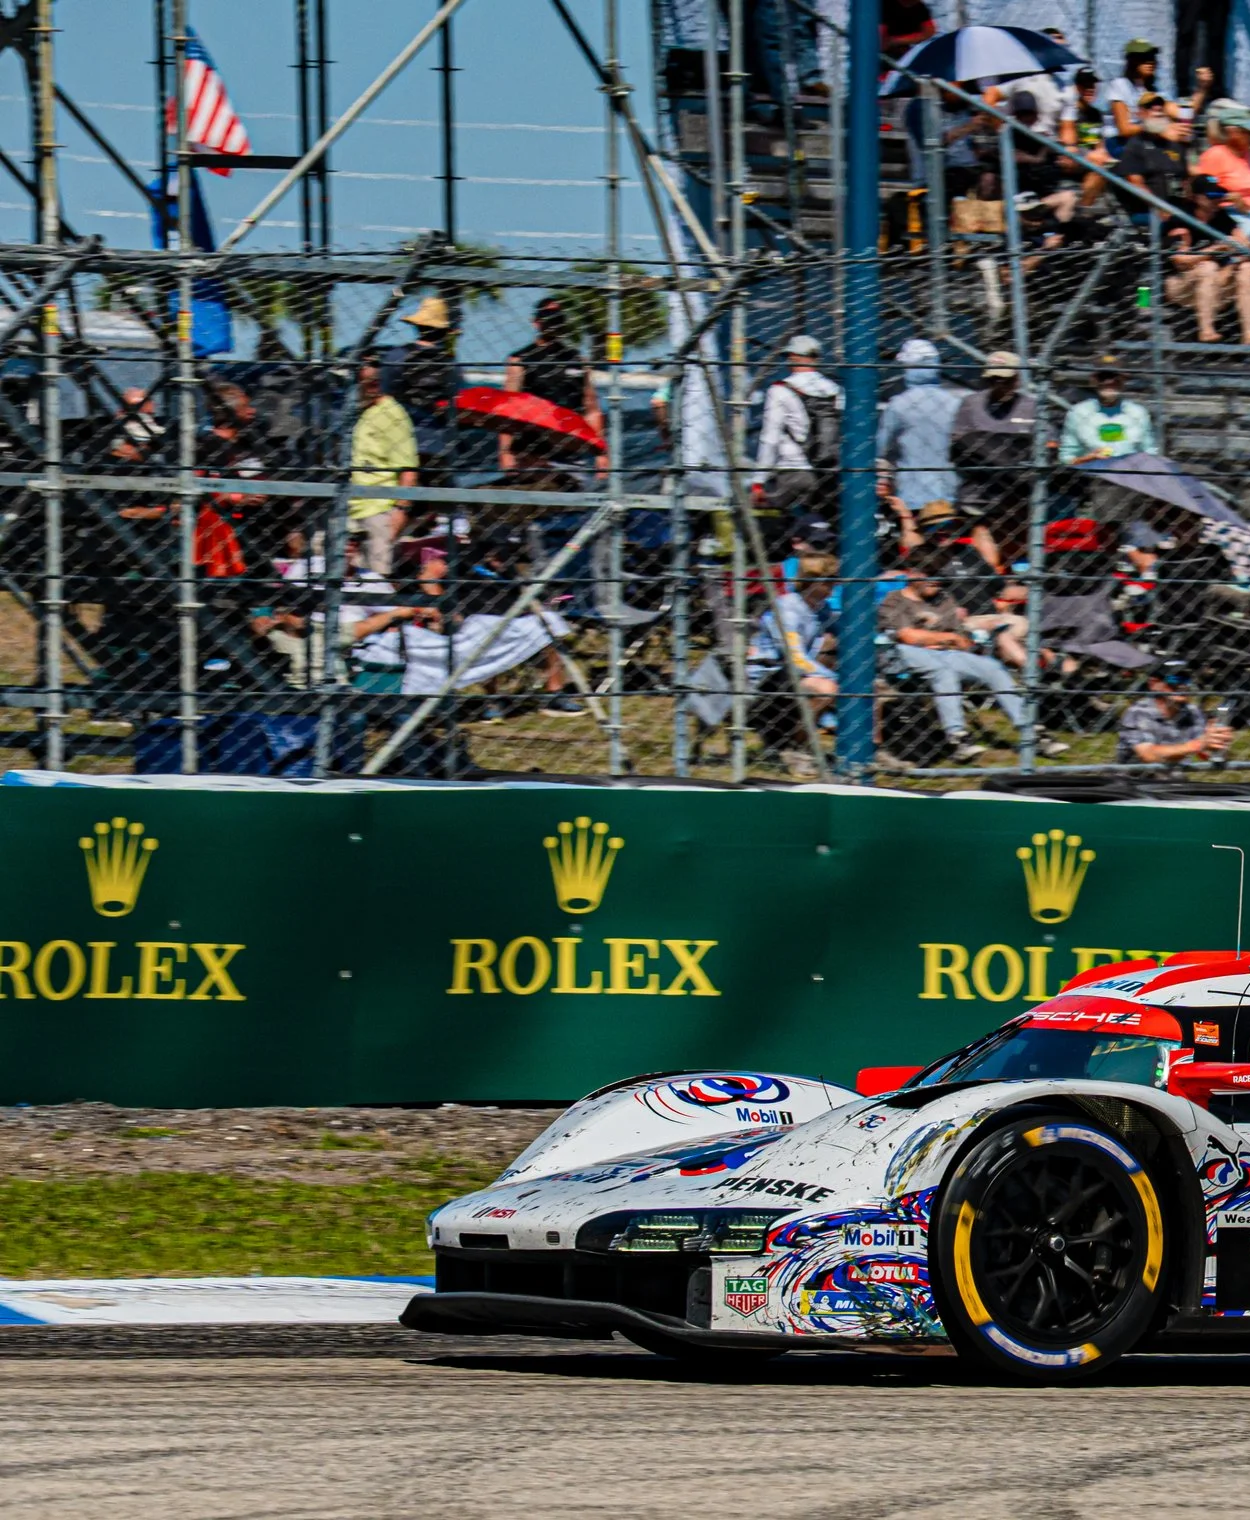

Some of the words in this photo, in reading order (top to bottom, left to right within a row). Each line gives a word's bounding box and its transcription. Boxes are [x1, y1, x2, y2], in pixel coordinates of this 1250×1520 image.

[0, 939, 247, 1001] ROLEX
[446, 935, 722, 997] ROLEX
[918, 943, 1176, 1002] ROL
[735, 1107, 778, 1124] Mobil
[781, 1111, 793, 1124] 1
[711, 1177, 835, 1204] PENSKE
[844, 1229, 895, 1247] Mobil
[901, 1230, 914, 1247] 1
[727, 1279, 765, 1293] TAG
[727, 1294, 767, 1314] HEUER
